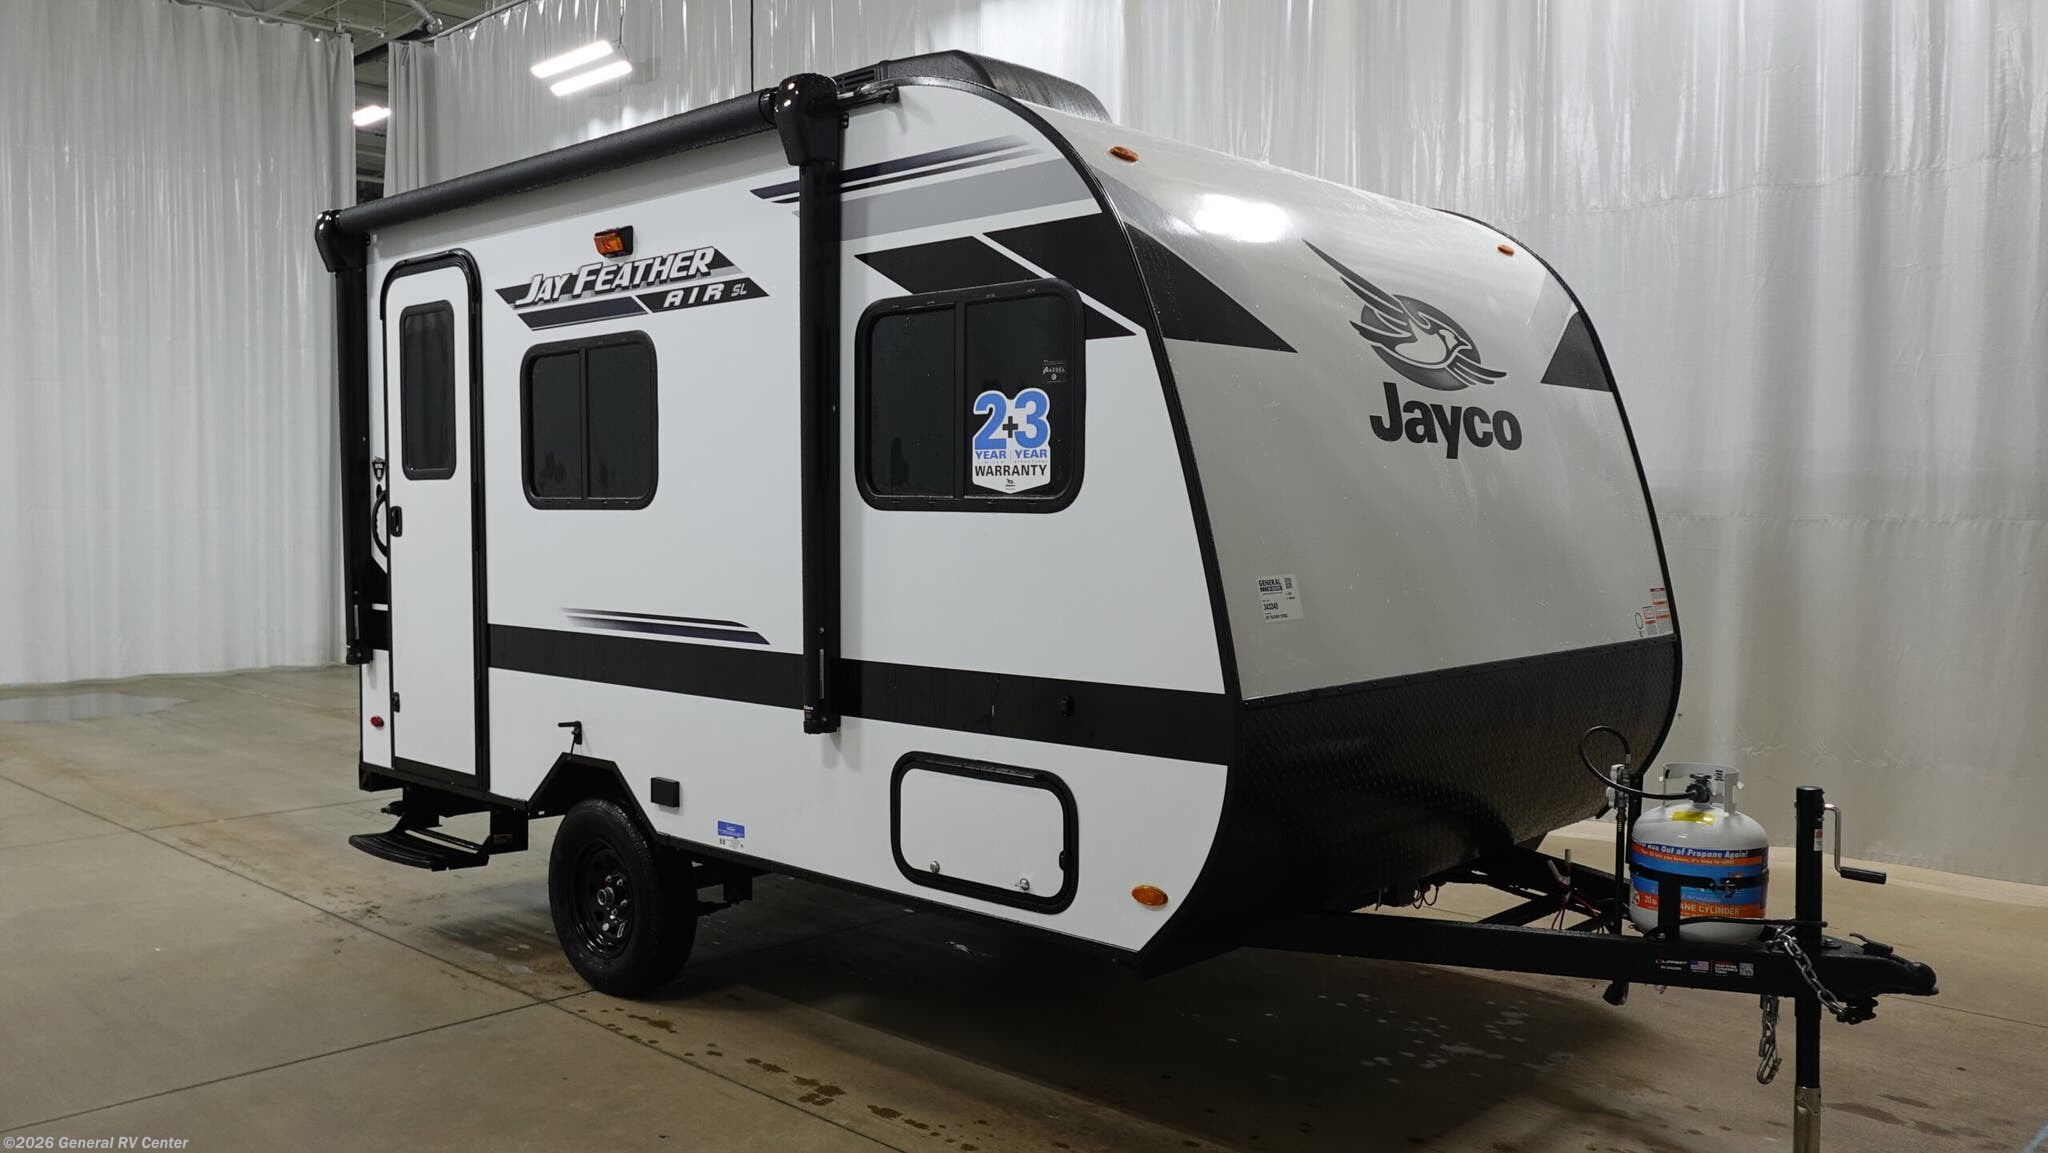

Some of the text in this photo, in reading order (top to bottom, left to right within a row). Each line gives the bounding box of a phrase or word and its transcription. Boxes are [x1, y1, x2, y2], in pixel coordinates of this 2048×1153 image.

[514, 247, 716, 307] JAY FEATHER
[663, 283, 748, 308] AIR SL
[1369, 381, 1523, 459] Jayco
[975, 449, 1048, 459] YEAR YEAR
[974, 464, 1048, 477] WARRANTY
[1676, 847, 1685, 856] of
[1687, 848, 1723, 858] Propane
[1698, 903, 1741, 915] CYLINDER
